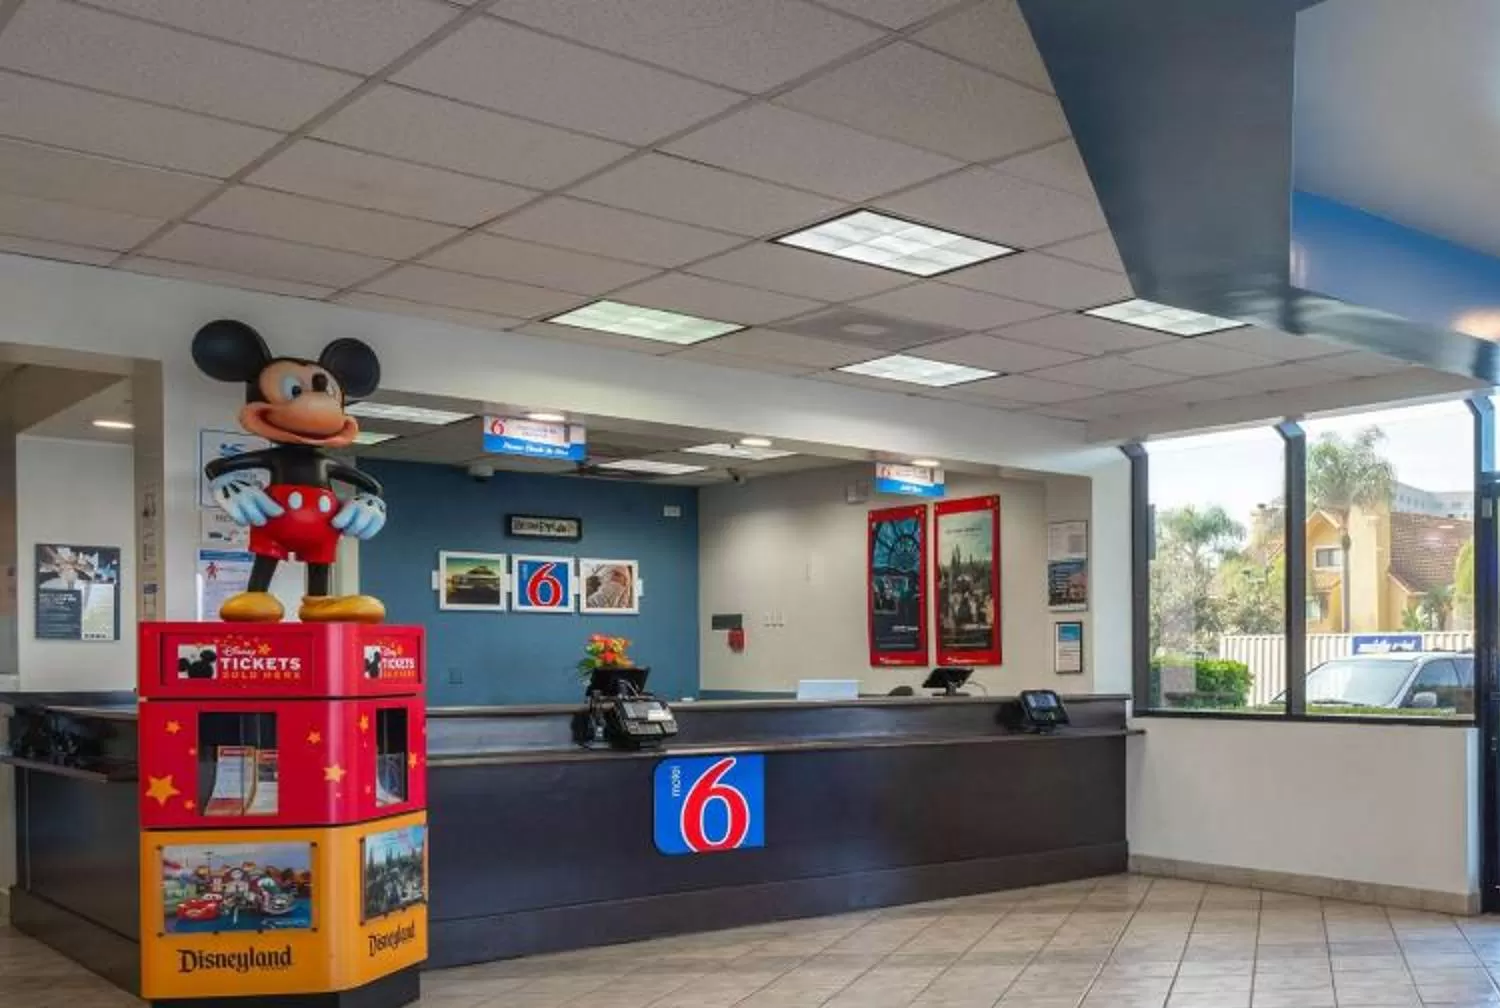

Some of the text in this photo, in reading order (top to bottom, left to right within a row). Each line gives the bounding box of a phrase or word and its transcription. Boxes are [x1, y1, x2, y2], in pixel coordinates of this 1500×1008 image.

[526, 562, 563, 608] 6
[220, 657, 301, 671] TICKETS
[680, 757, 751, 853] 6
[368, 919, 414, 957] Disneyland
[176, 944, 293, 973] Disneyland
